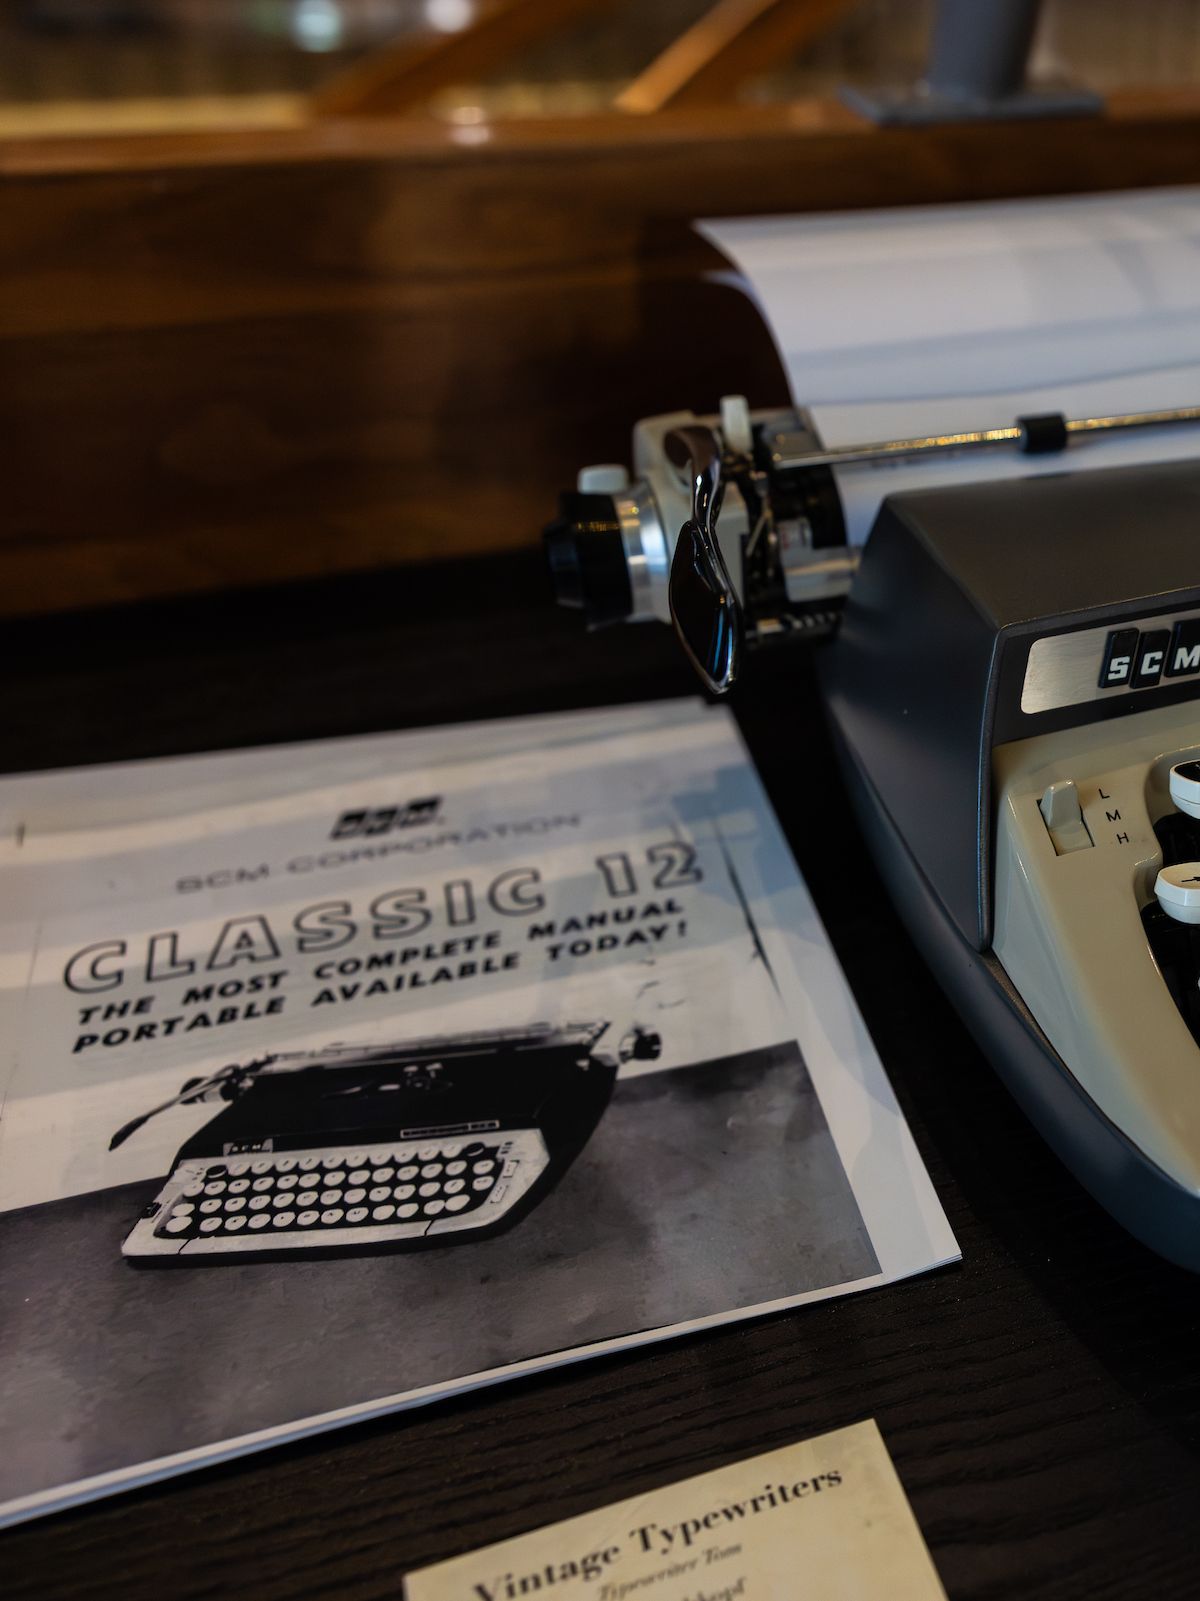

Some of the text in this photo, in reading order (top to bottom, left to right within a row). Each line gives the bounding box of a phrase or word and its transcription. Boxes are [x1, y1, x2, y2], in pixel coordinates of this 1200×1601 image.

[1098, 788, 1110, 799] L
[1105, 809, 1121, 822] M
[1116, 832, 1129, 844] H
[286, 812, 582, 874] CORPORATION
[63, 839, 703, 995] CLASSIC 12
[78, 898, 683, 1025] THE MOST COMPLETE MANUAL
[72, 920, 688, 1054] PORTABLE AVAILABLE TODAY!
[473, 1469, 843, 1601] Vintage Typewriters
